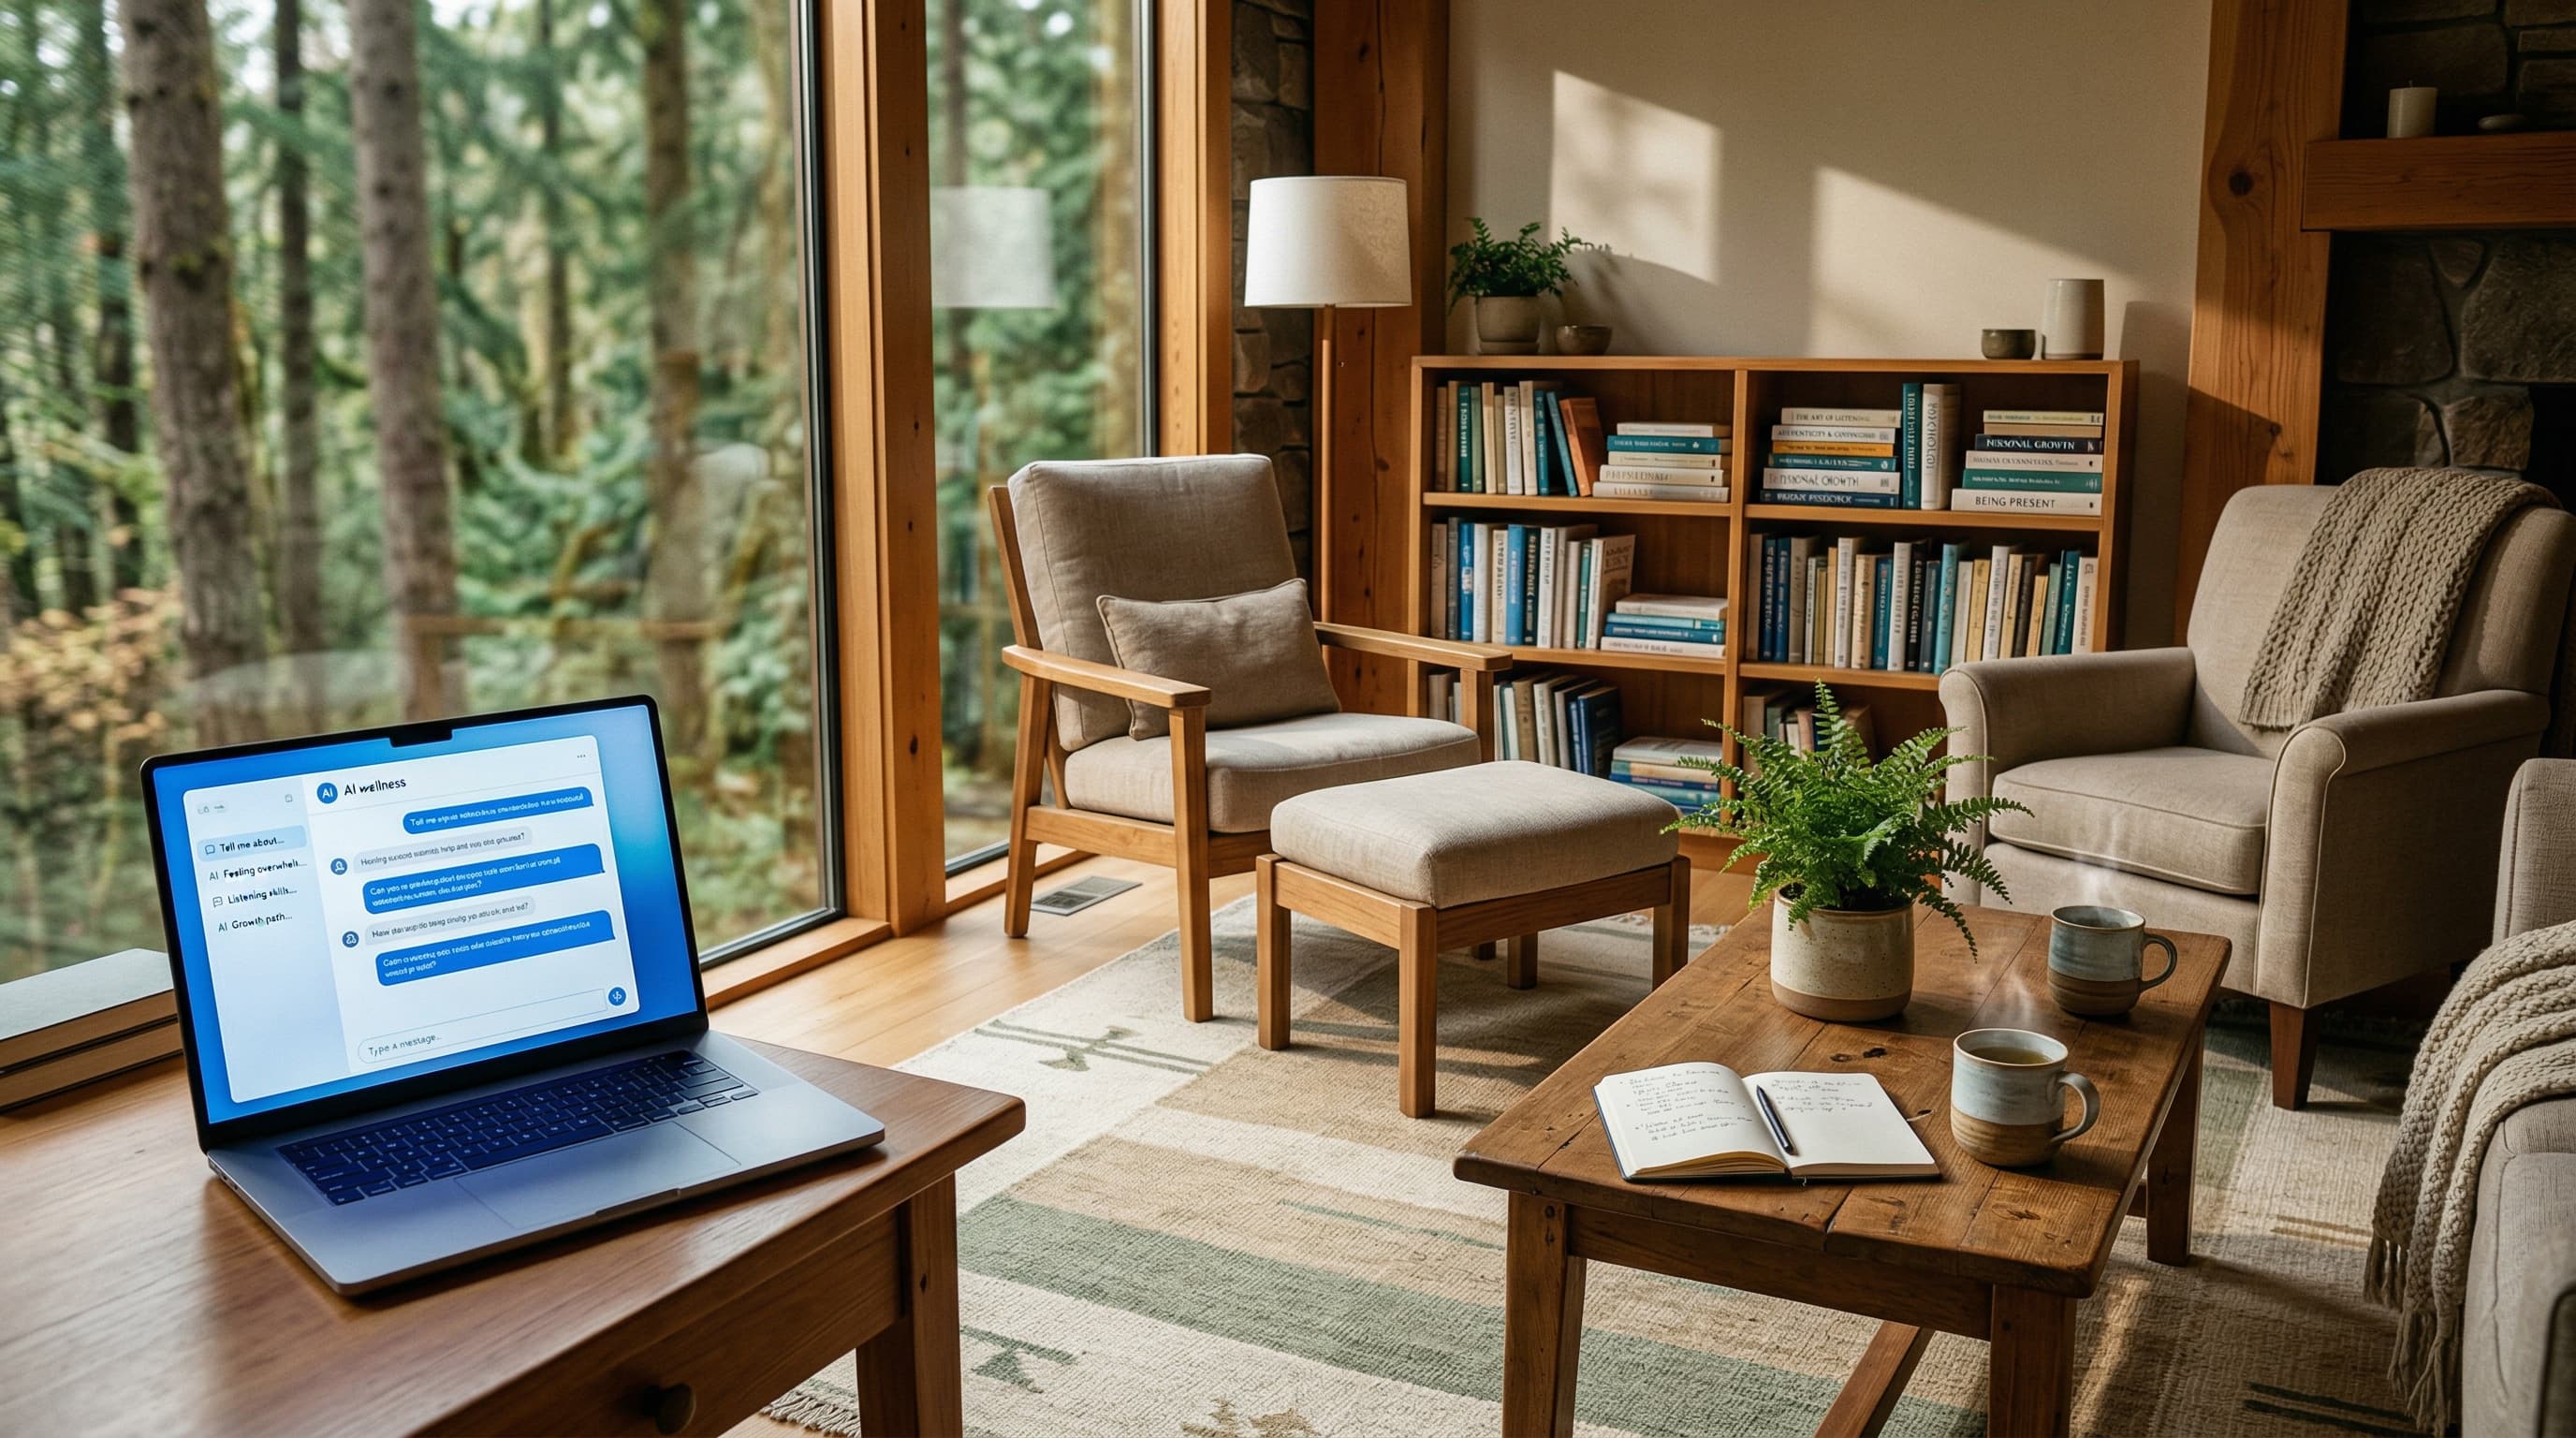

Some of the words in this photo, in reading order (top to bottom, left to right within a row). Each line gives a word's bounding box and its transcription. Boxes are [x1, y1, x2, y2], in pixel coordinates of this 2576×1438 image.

[1975, 496, 2007, 507] BEING
[2010, 497, 2056, 508] PRESENT
[322, 787, 333, 799] AI
[344, 784, 357, 797] AI
[359, 778, 407, 794] wellness
[219, 842, 236, 854] Tell
[238, 841, 251, 850] me
[209, 871, 219, 882] AI
[227, 890, 268, 905] Listening
[218, 922, 227, 932] AI
[231, 917, 264, 930] Growth
[368, 1044, 390, 1057] Type
